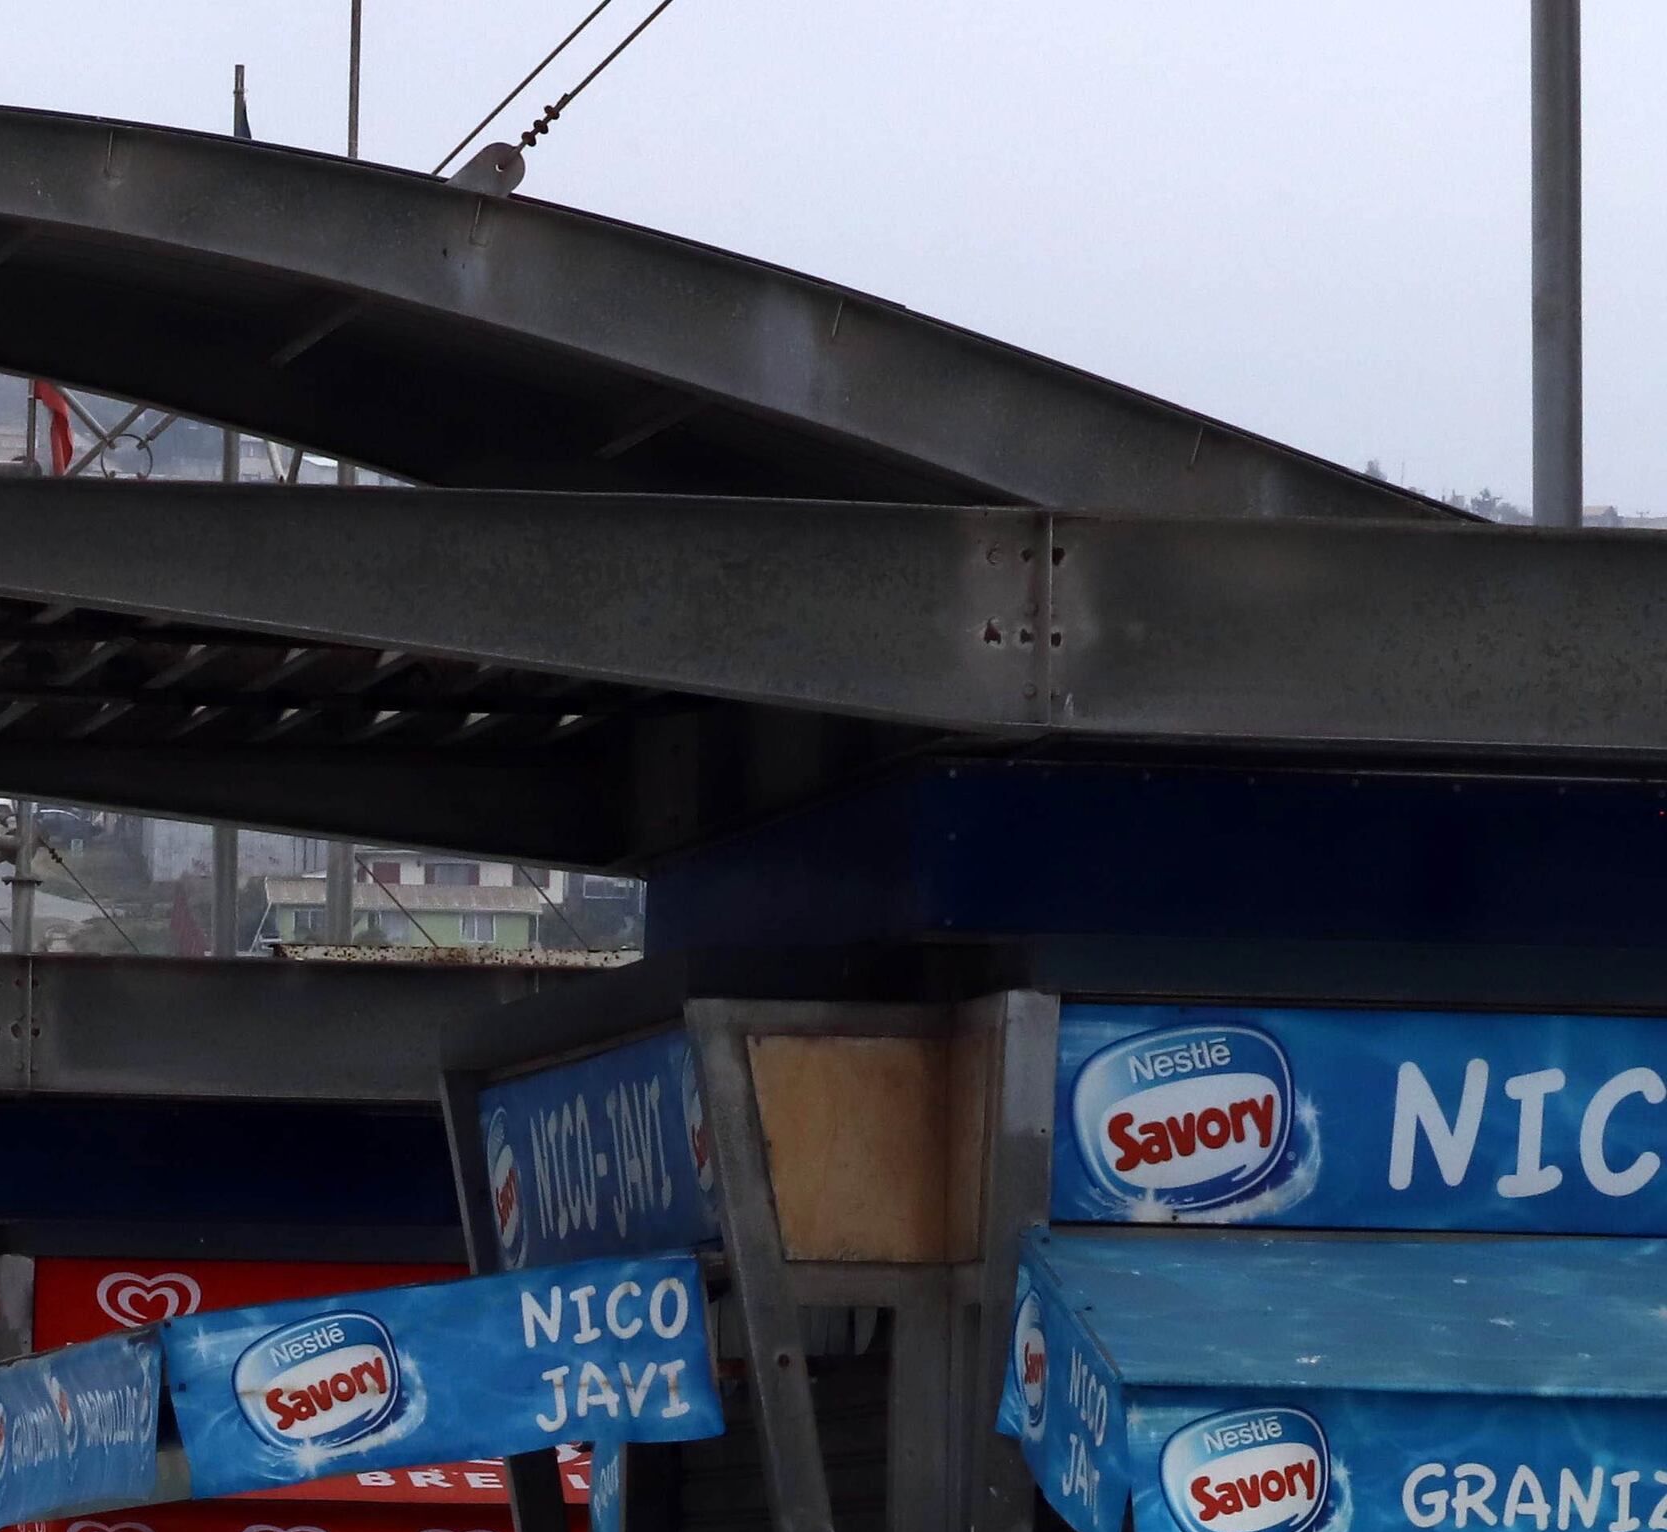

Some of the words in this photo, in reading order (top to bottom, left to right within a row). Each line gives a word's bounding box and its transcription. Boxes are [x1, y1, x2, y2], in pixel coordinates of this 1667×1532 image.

[1107, 1094, 1274, 1173] Savory
[1388, 1057, 1667, 1199] NIC
[521, 1277, 689, 1349] NICO
[266, 1357, 386, 1430] Savory
[536, 1358, 691, 1433] JAVI
[1070, 1348, 1107, 1447] NICO
[1190, 1458, 1316, 1523] Savory
